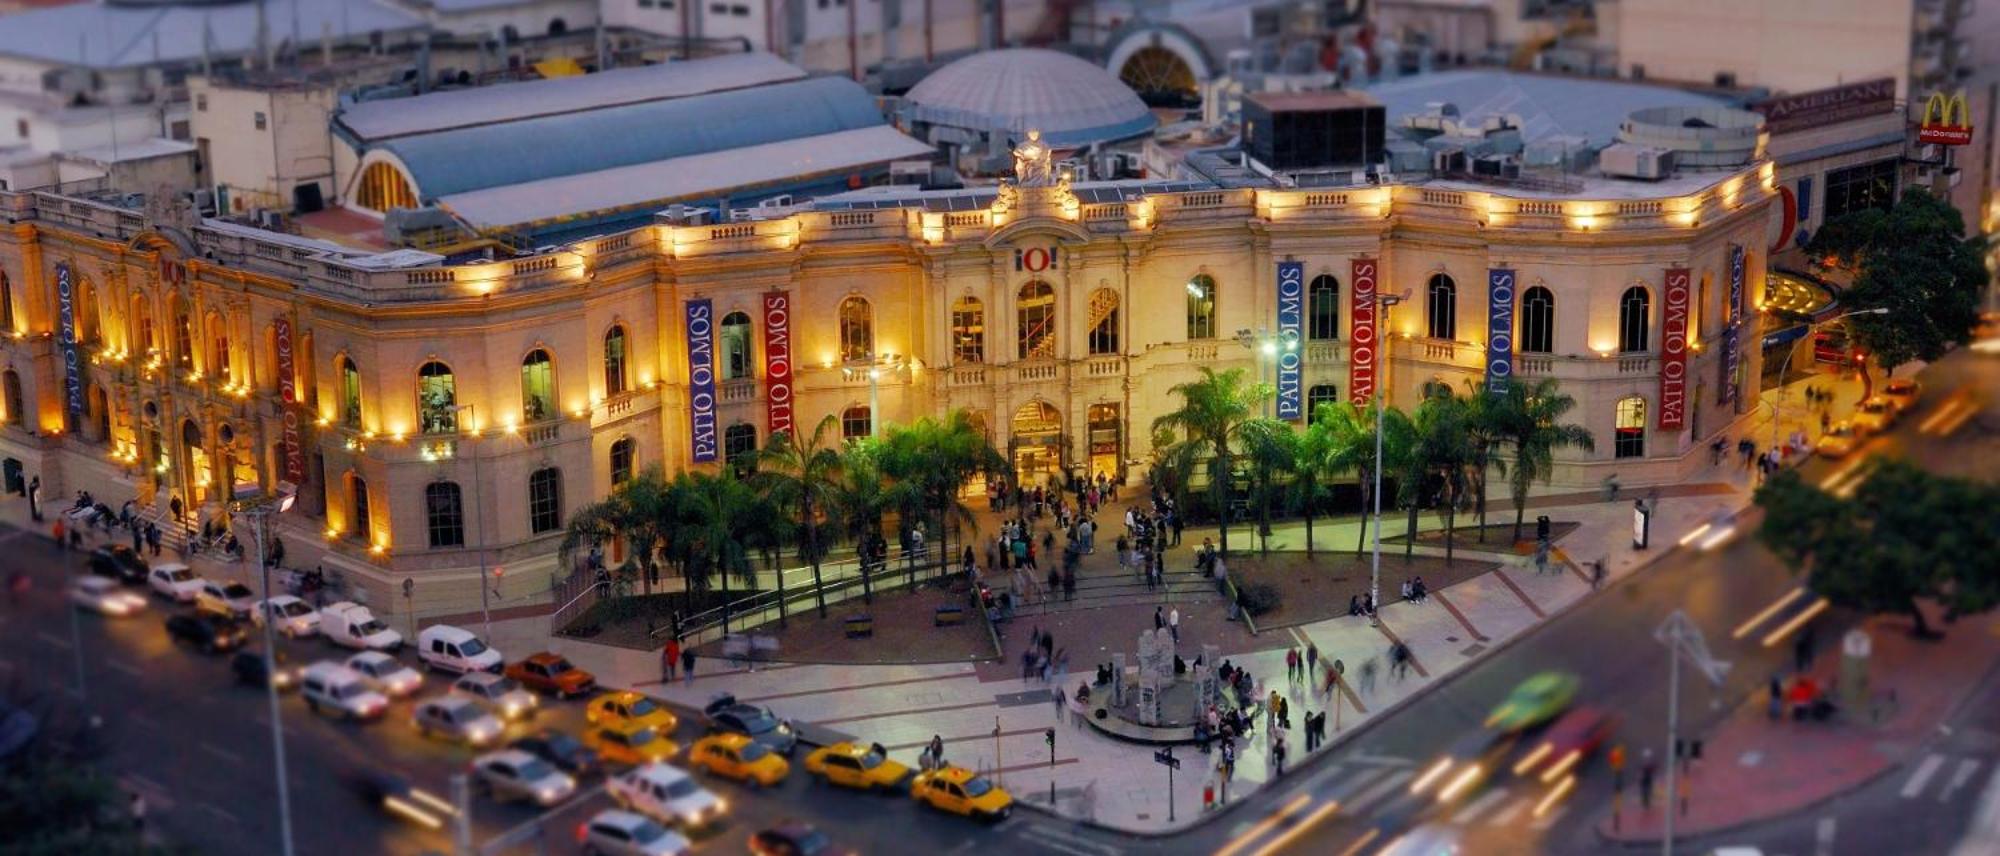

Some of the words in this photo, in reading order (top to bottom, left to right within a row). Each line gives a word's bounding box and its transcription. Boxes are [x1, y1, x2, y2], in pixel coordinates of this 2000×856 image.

[58, 269, 75, 344] OLMOS
[1354, 264, 1374, 343] OLMOS
[1492, 274, 1513, 352] OLMOS
[1666, 274, 1688, 354] OLMOS
[278, 322, 295, 404] OLMOS
[690, 305, 712, 386] OLMOS
[768, 296, 788, 378] OLMOS
[65, 348, 82, 408] PATIO
[1280, 352, 1299, 414] PATIO
[1353, 347, 1372, 408] PATIO
[1489, 359, 1510, 395] TIO
[1663, 361, 1684, 424] PATIO
[284, 412, 301, 476] PATIO
[693, 392, 715, 457] PATIO
[770, 384, 791, 446] ATIO
